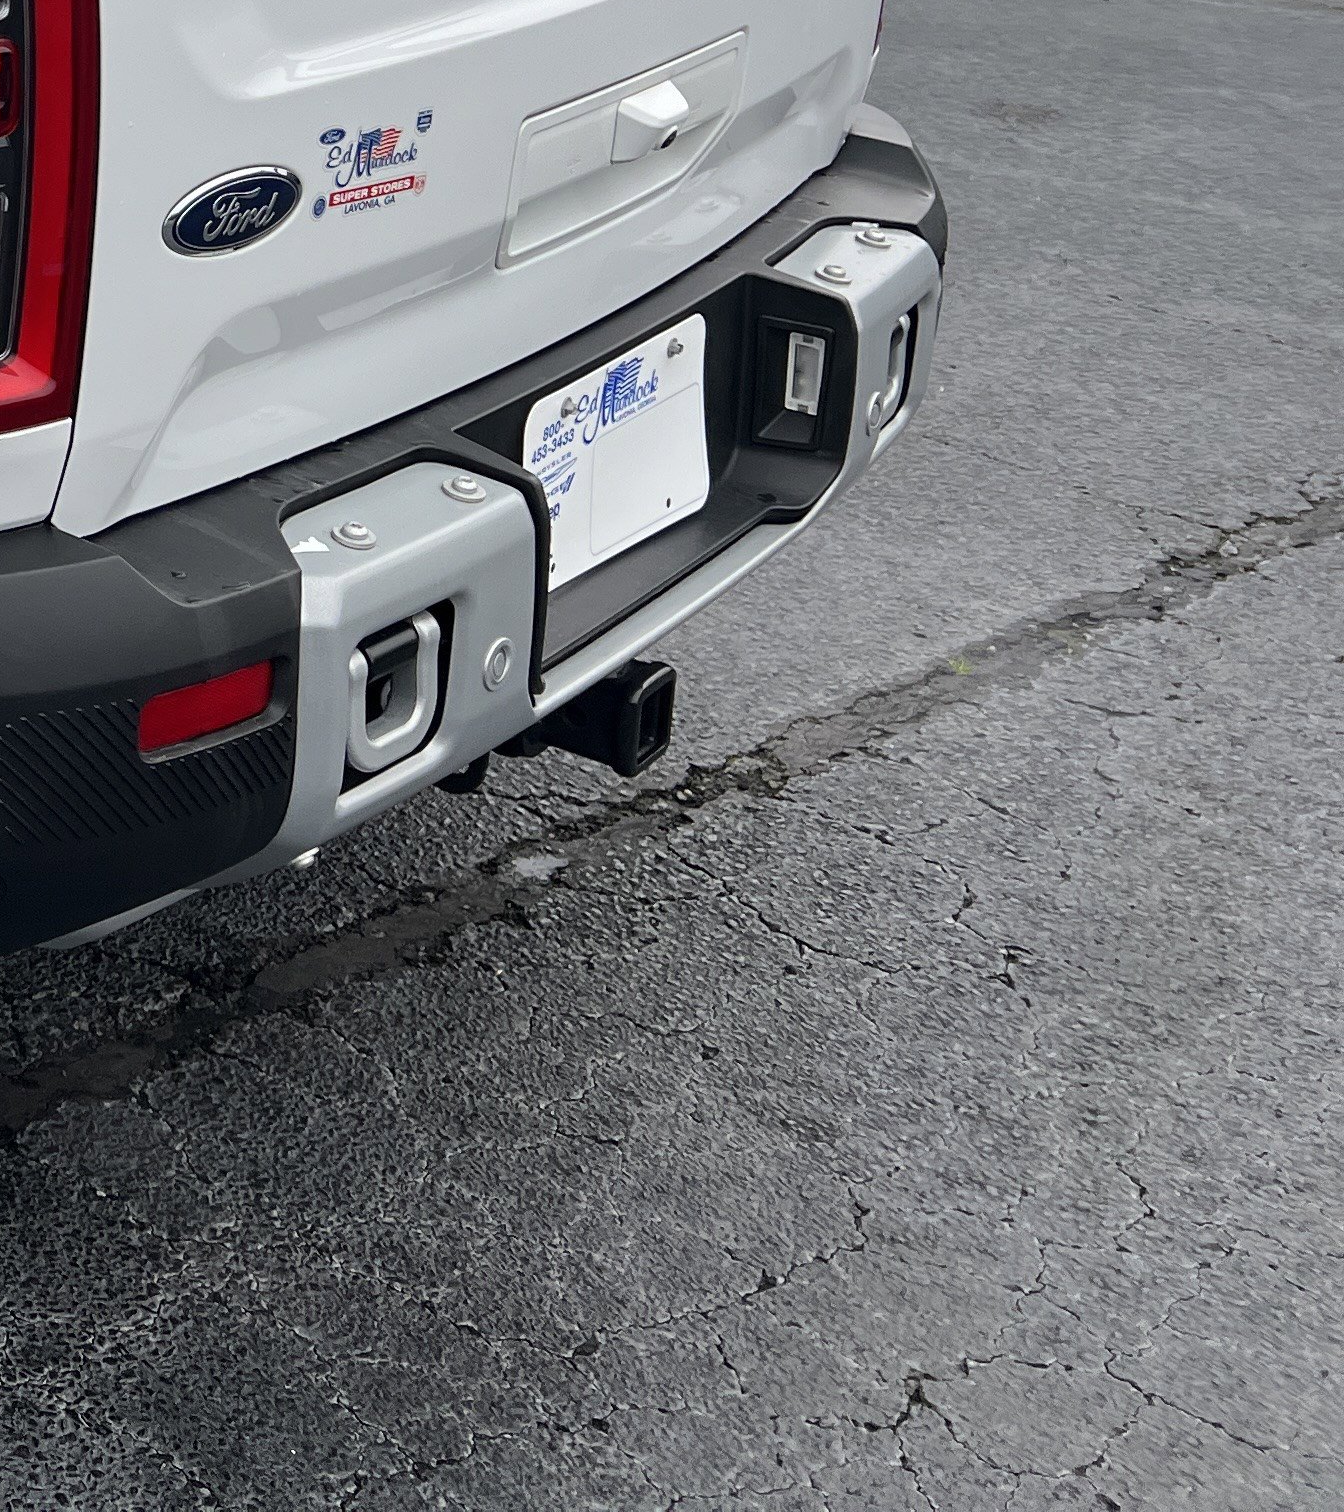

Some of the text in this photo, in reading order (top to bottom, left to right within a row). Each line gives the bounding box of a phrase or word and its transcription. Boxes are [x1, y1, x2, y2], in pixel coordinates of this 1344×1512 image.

[325, 143, 354, 169] Ed
[332, 188, 368, 205] SUPER
[371, 179, 411, 197] STORES
[383, 195, 396, 206] GA
[203, 185, 279, 243] Ford
[574, 386, 600, 424] Ed
[531, 428, 575, 465] 453-3433
